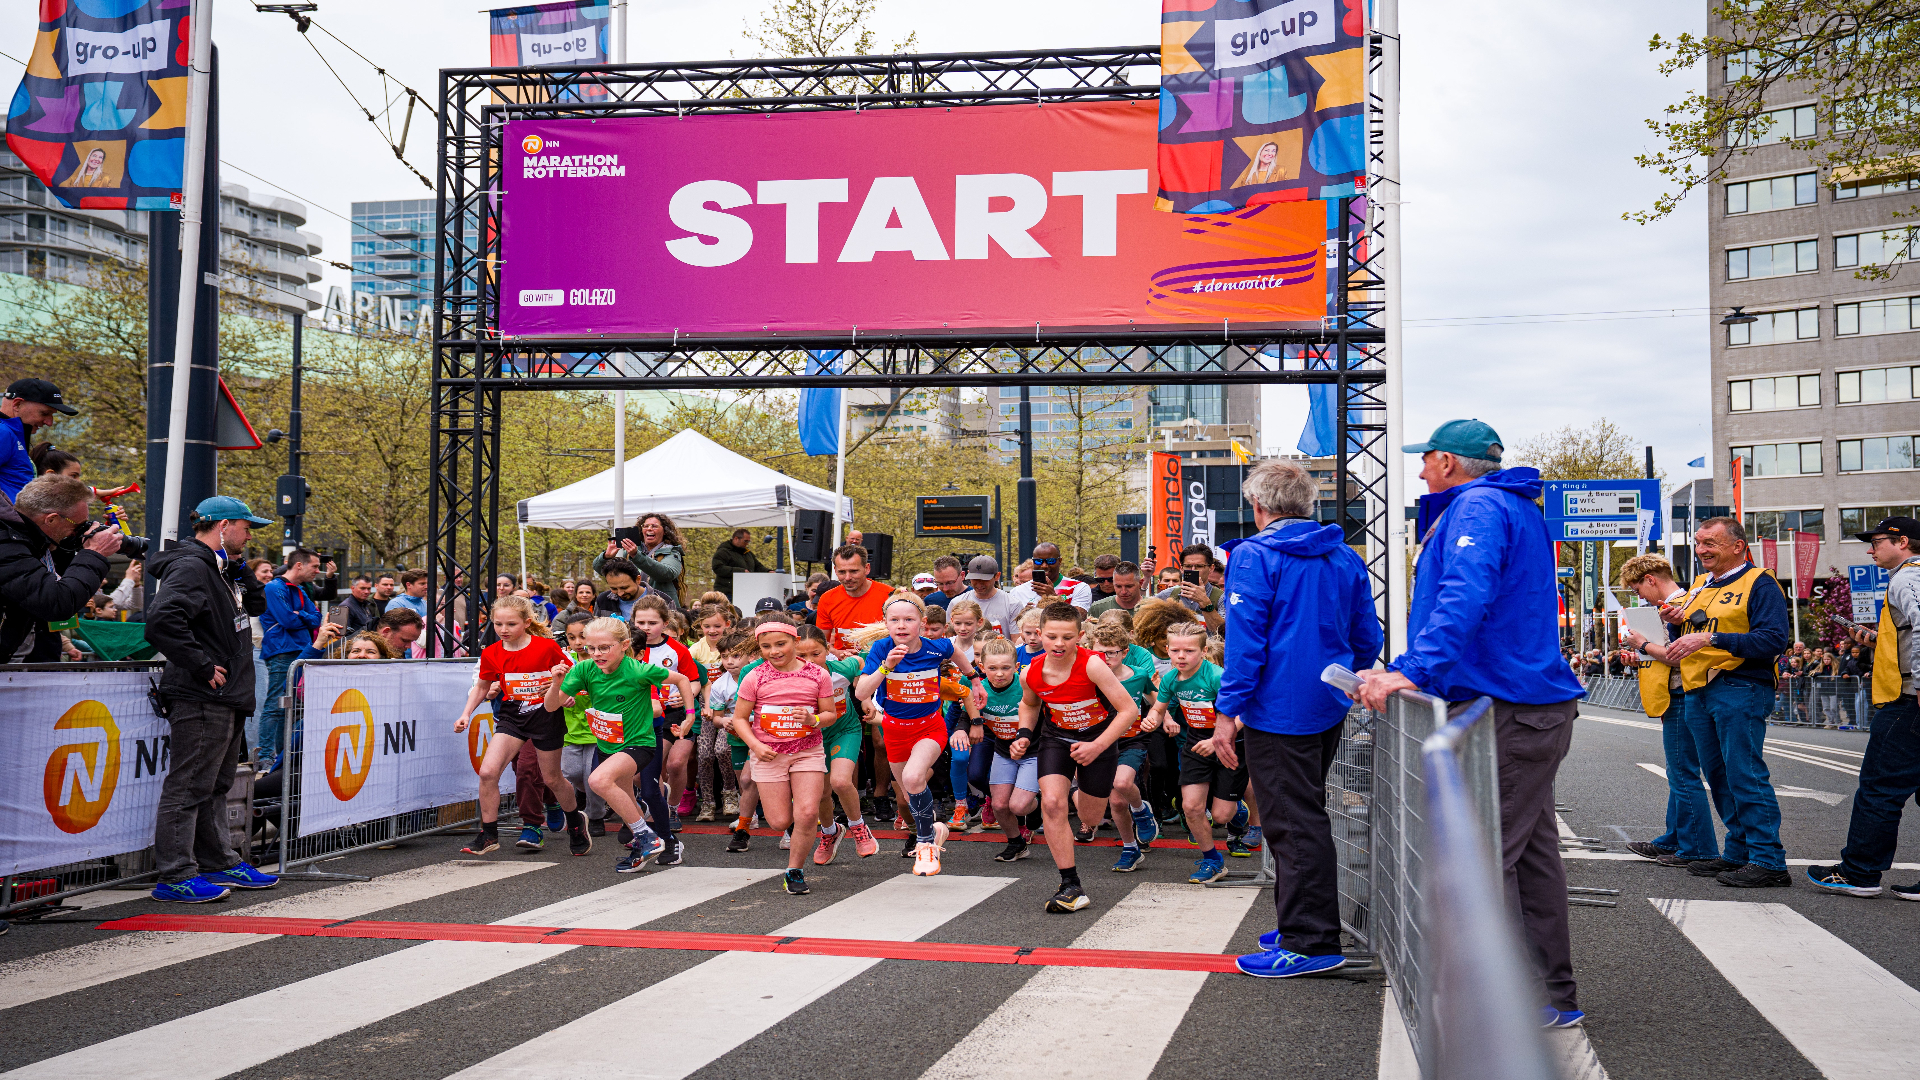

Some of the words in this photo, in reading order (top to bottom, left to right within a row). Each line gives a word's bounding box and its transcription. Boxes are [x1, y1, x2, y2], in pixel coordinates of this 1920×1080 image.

[1230, 10, 1318, 57] gro-up
[75, 36, 157, 65] gro-up
[545, 140, 560, 148] NN
[523, 154, 618, 168] MARATHON
[523, 165, 626, 179] ROTTERDAM
[664, 168, 1149, 268] START
[1192, 274, 1284, 294] #demooiste
[523, 293, 534, 303] GO
[535, 293, 554, 303] WITH
[569, 288, 616, 306] GOLAZO
[1188, 481, 1208, 545] ando
[1719, 592, 1744, 606] 31
[900, 687, 927, 695] FILIA
[770, 721, 803, 729] FLEUR
[383, 719, 417, 755] NN
